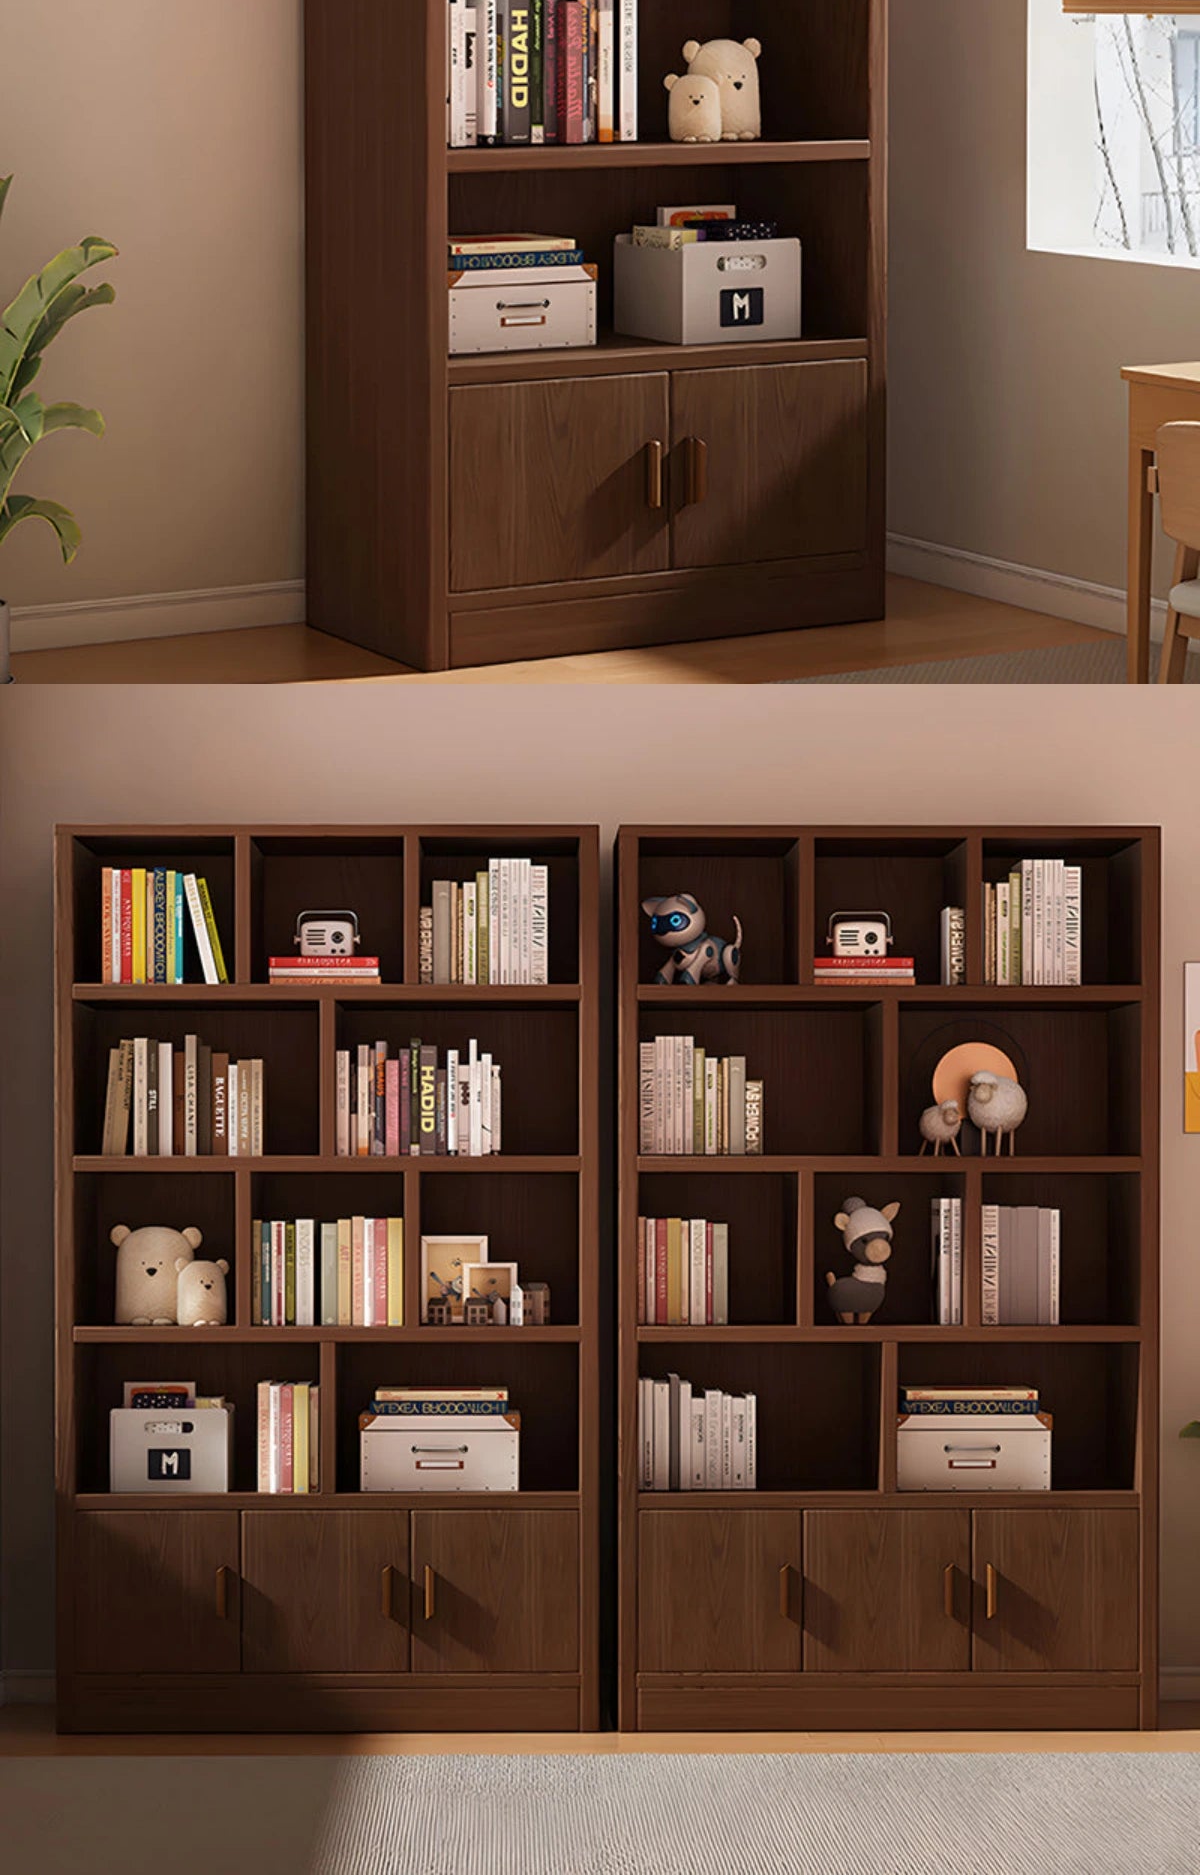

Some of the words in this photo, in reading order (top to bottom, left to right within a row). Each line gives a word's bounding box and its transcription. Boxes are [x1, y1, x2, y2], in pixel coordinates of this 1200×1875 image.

[536, 251, 581, 266] ALEXEY
[732, 291, 751, 322] M
[155, 870, 165, 909] ALEXEY
[155, 912, 165, 978] BRODOVITCH
[187, 1064, 195, 1088] LISA
[148, 1089, 157, 1111] STILL
[187, 1092, 195, 1135] CHANEY
[214, 1076, 225, 1138] BAGUETTE
[420, 1065, 435, 1133] HADID
[745, 1102, 759, 1141] POWER
[340, 1245, 349, 1261] ART
[161, 1451, 179, 1475] M
